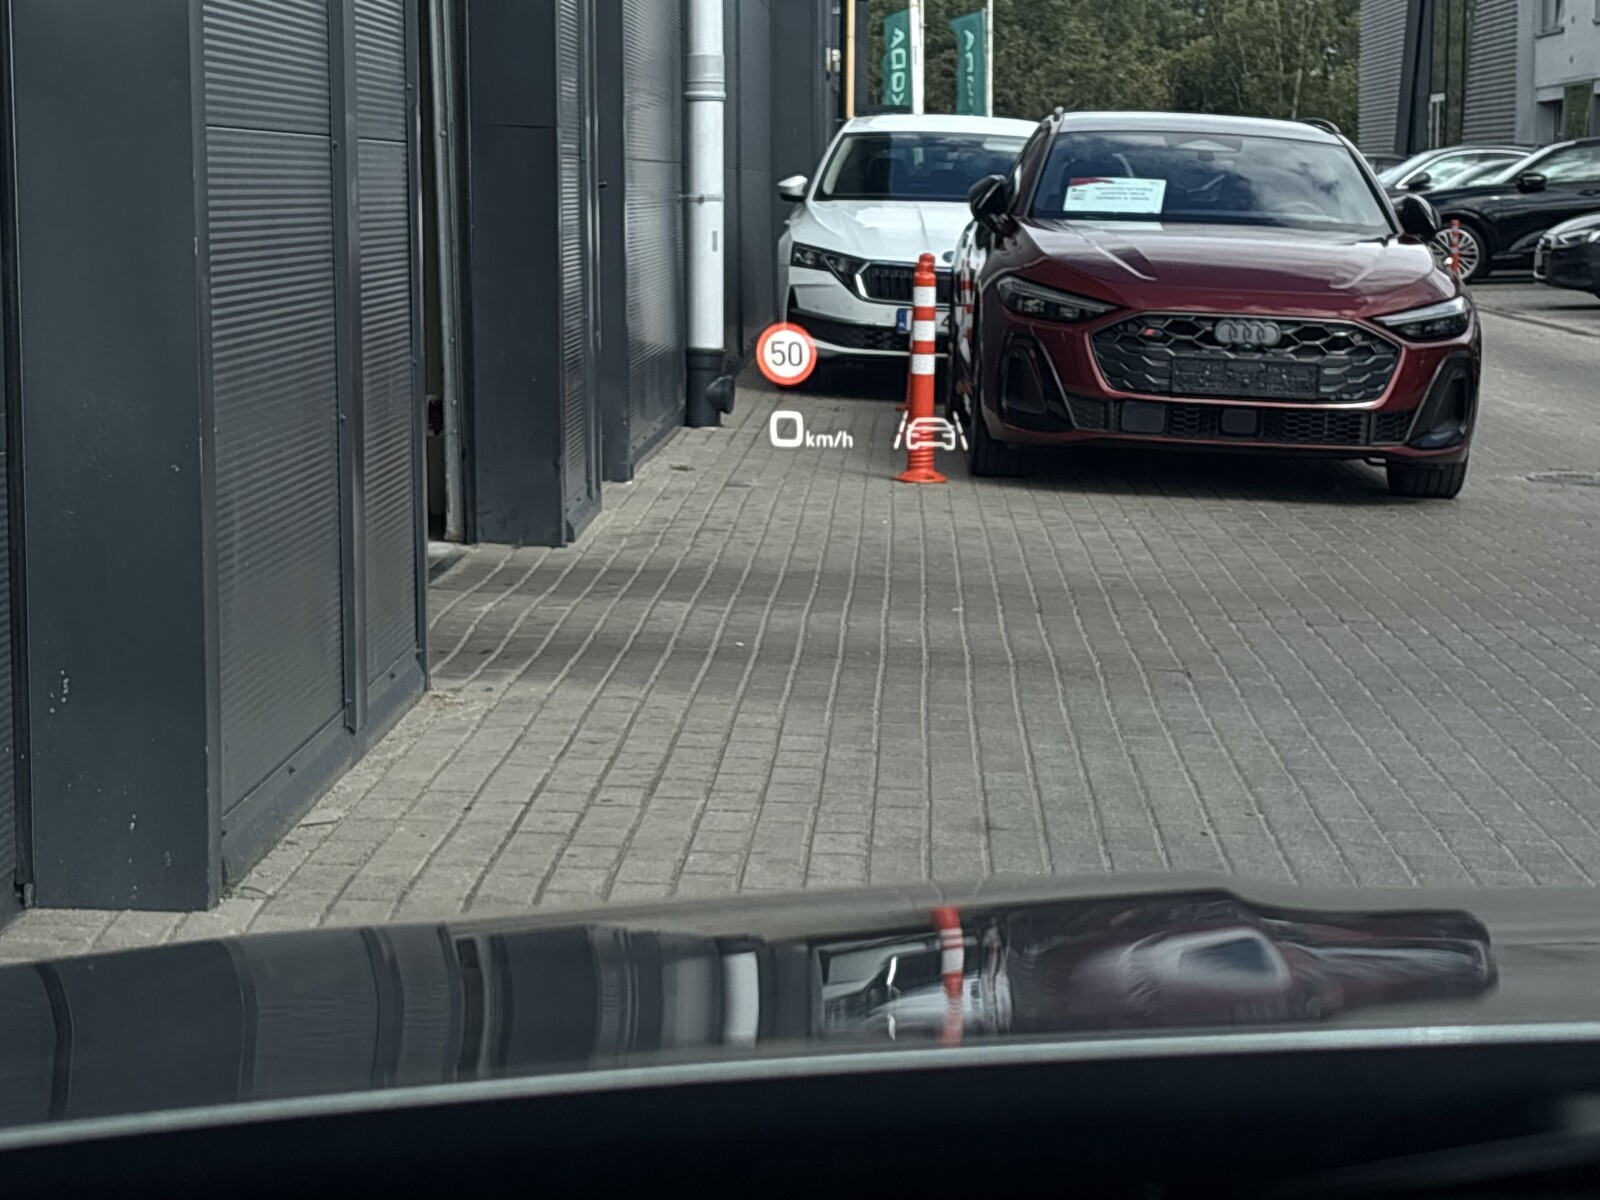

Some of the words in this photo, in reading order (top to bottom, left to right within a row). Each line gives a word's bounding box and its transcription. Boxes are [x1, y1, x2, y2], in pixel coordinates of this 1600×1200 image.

[771, 340, 803, 367] 50
[769, 410, 804, 448] 0
[805, 430, 854, 449] km/h
